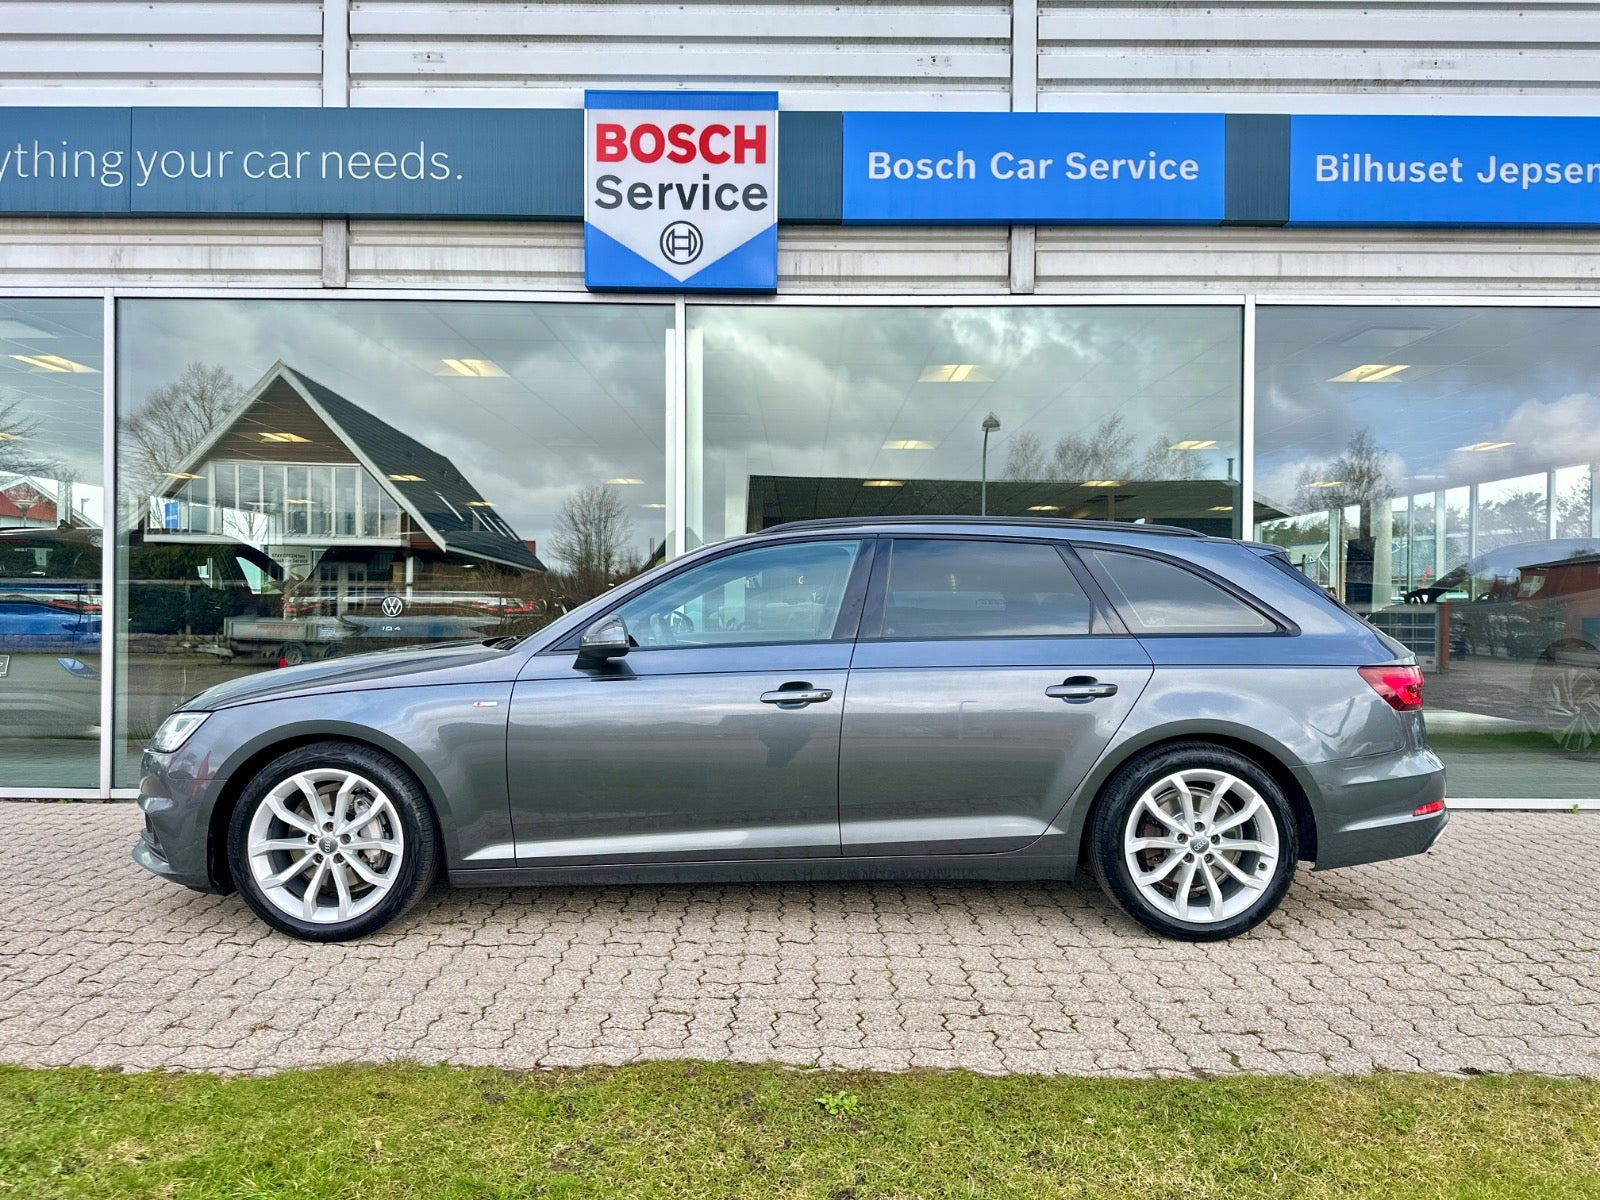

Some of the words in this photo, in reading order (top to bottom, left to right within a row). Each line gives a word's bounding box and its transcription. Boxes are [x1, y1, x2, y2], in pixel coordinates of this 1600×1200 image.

[596, 123, 767, 165] BOSCH
[136, 150, 234, 187] your
[243, 151, 311, 180] car
[321, 140, 463, 181] needs.
[868, 150, 976, 180] Bosch
[990, 151, 1053, 180] Car
[1065, 150, 1199, 181] Service
[1316, 153, 1463, 183] Bilhuset
[1476, 155, 1600, 190] Jepsen
[594, 174, 768, 212] Service
